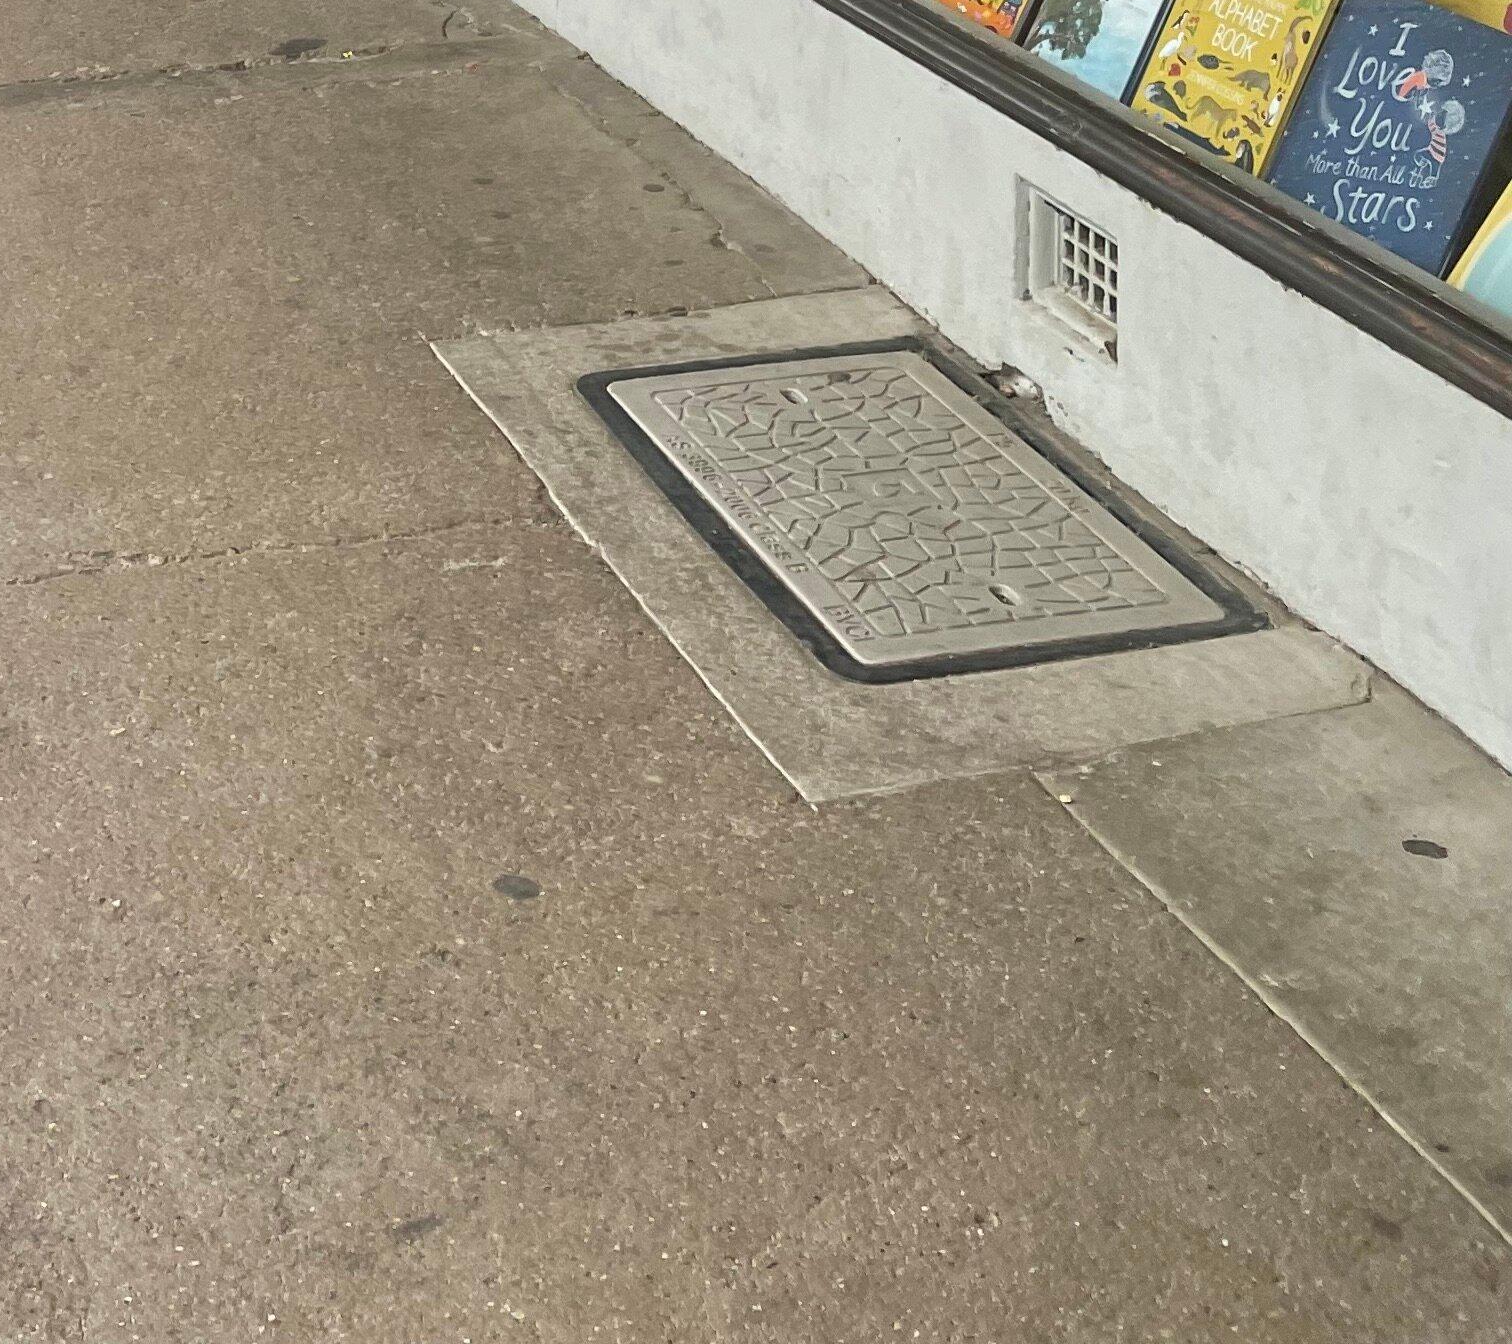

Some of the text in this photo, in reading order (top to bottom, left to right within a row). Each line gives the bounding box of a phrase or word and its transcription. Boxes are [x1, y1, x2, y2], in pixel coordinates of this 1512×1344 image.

[1211, 23, 1259, 62] BOOK
[1388, 22, 1419, 57] I
[1333, 44, 1416, 102] Love
[1343, 96, 1413, 155] You
[1305, 152, 1343, 177] More
[1345, 157, 1380, 182] than
[1332, 178, 1419, 233] Stars
